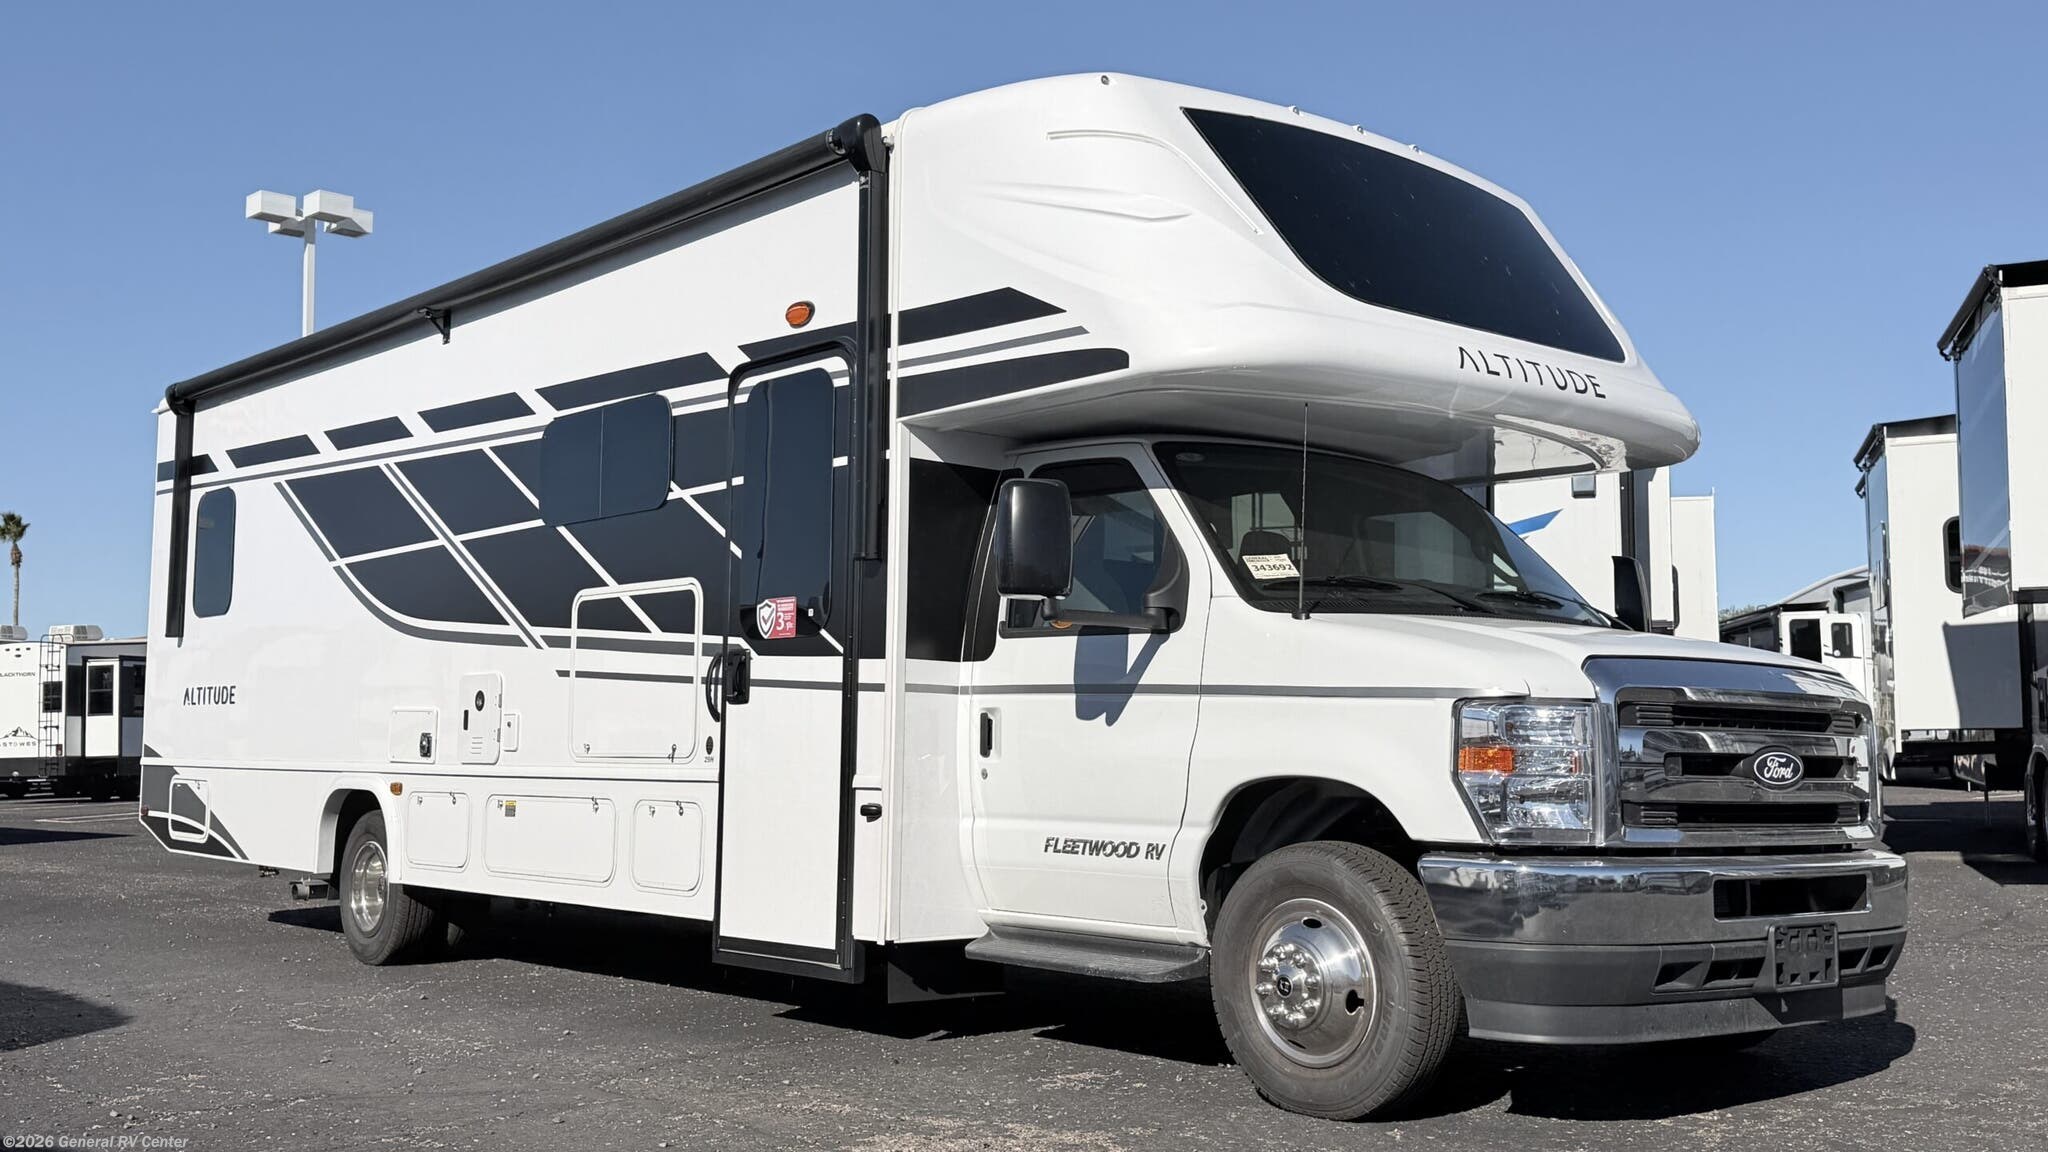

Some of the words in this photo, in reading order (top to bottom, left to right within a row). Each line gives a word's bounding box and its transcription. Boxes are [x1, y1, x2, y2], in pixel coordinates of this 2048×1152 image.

[1458, 346, 1606, 399] ALTITUDE
[1251, 563, 1294, 572] 343692
[776, 612, 785, 631] 3
[183, 685, 236, 706] ALTITUDE
[1763, 756, 1794, 779] Ford
[1043, 836, 1141, 859] FLEETWOOD
[1144, 842, 1167, 861] RV
